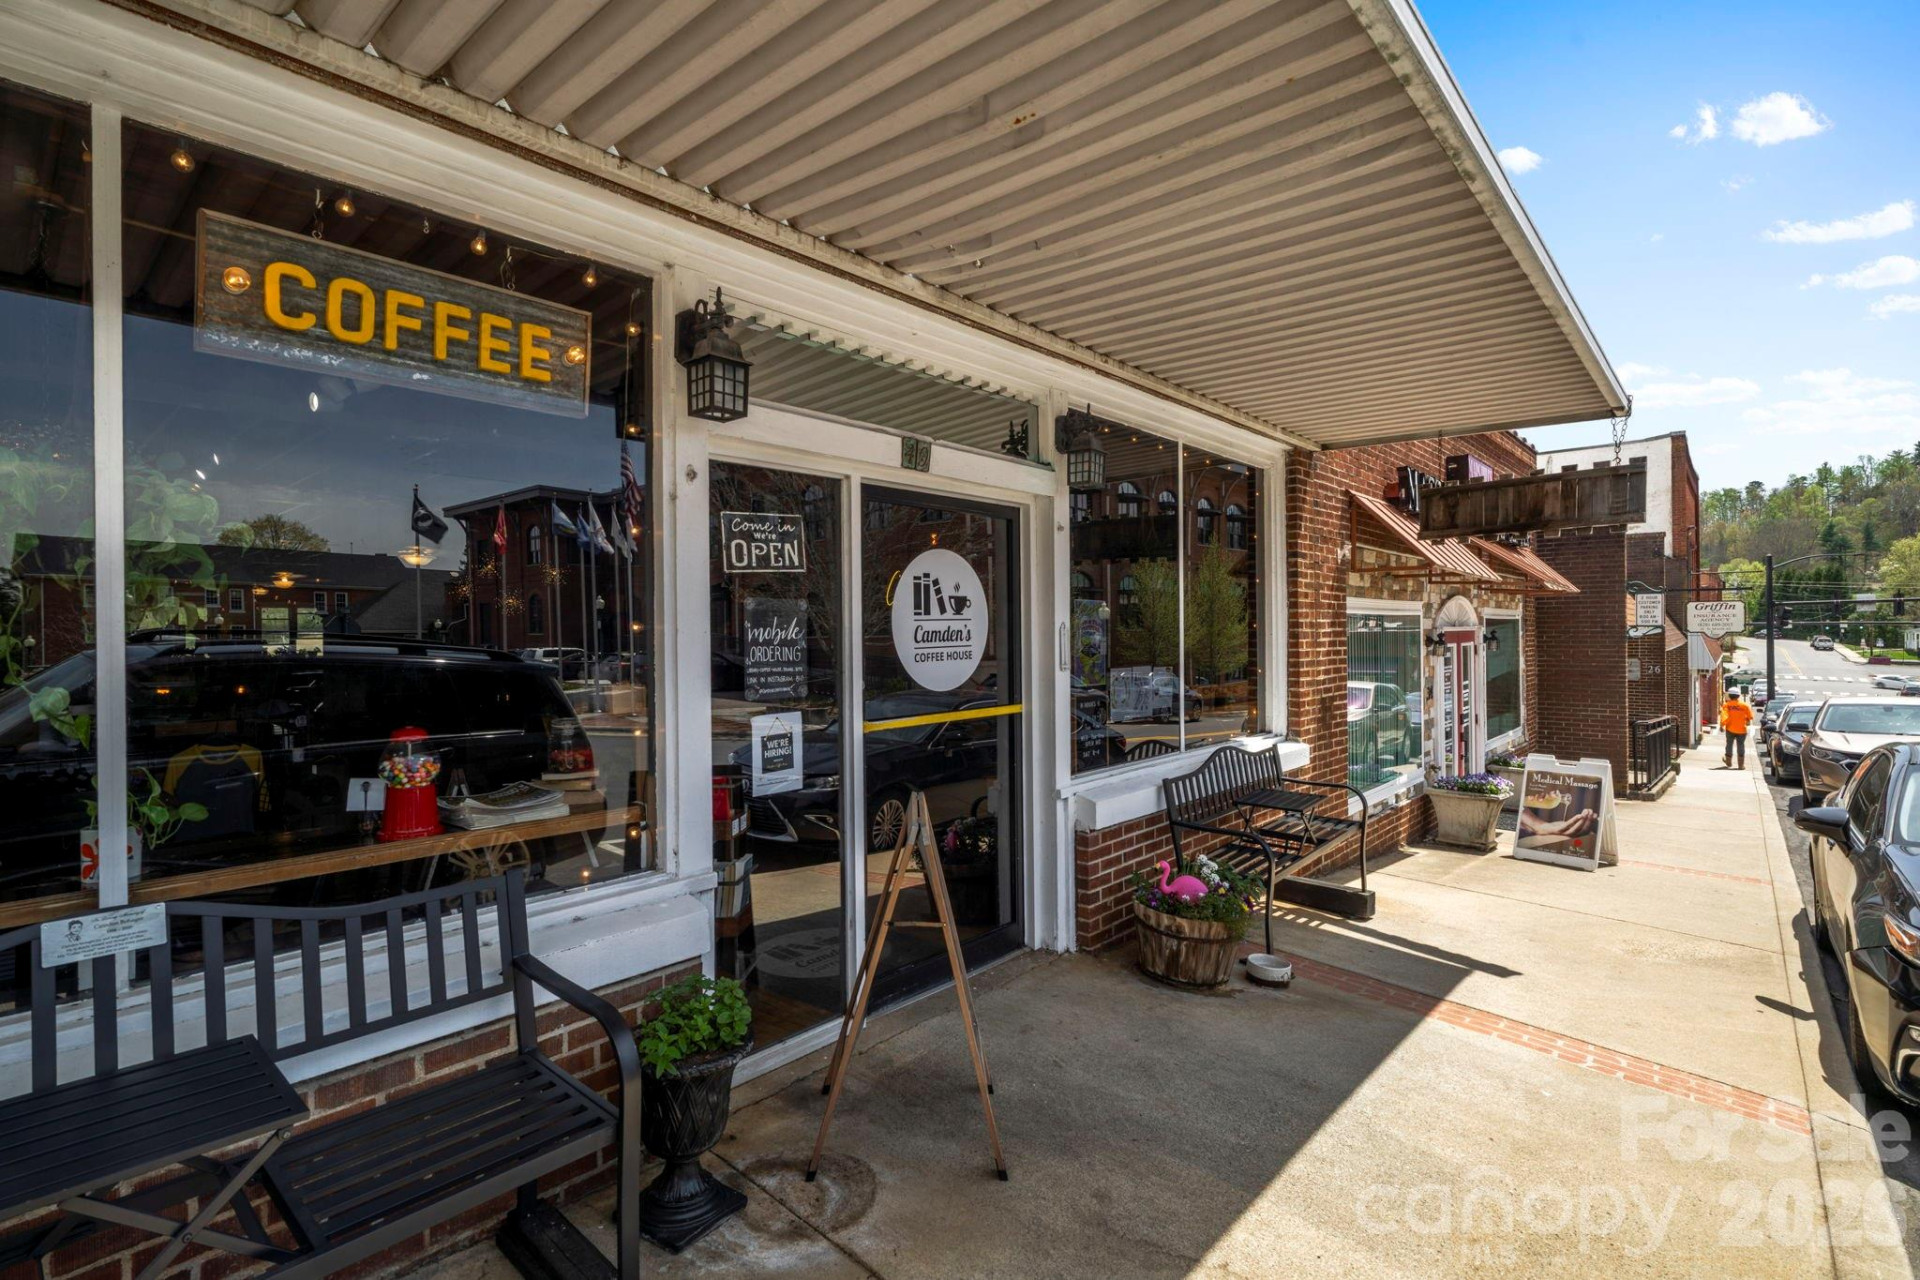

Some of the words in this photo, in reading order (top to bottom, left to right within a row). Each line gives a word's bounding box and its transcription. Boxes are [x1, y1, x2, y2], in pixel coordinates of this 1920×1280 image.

[264, 261, 552, 383] COFFEE
[731, 518, 774, 532] Come
[778, 519, 796, 533] in
[753, 532, 777, 540] We're
[731, 539, 799, 567] OPEN
[1694, 602, 1736, 612] Griffin
[748, 616, 805, 645] mobile
[914, 624, 972, 644] Camden's
[750, 646, 801, 662] ORDERING
[914, 651, 945, 663] COFFEE
[946, 650, 973, 662] HOUSE
[1648, 665, 1661, 674] 26
[766, 738, 790, 749] WE'RE
[764, 746, 793, 759] HIRING!
[1532, 773, 1563, 785] Medical
[1564, 776, 1599, 790] Massage
